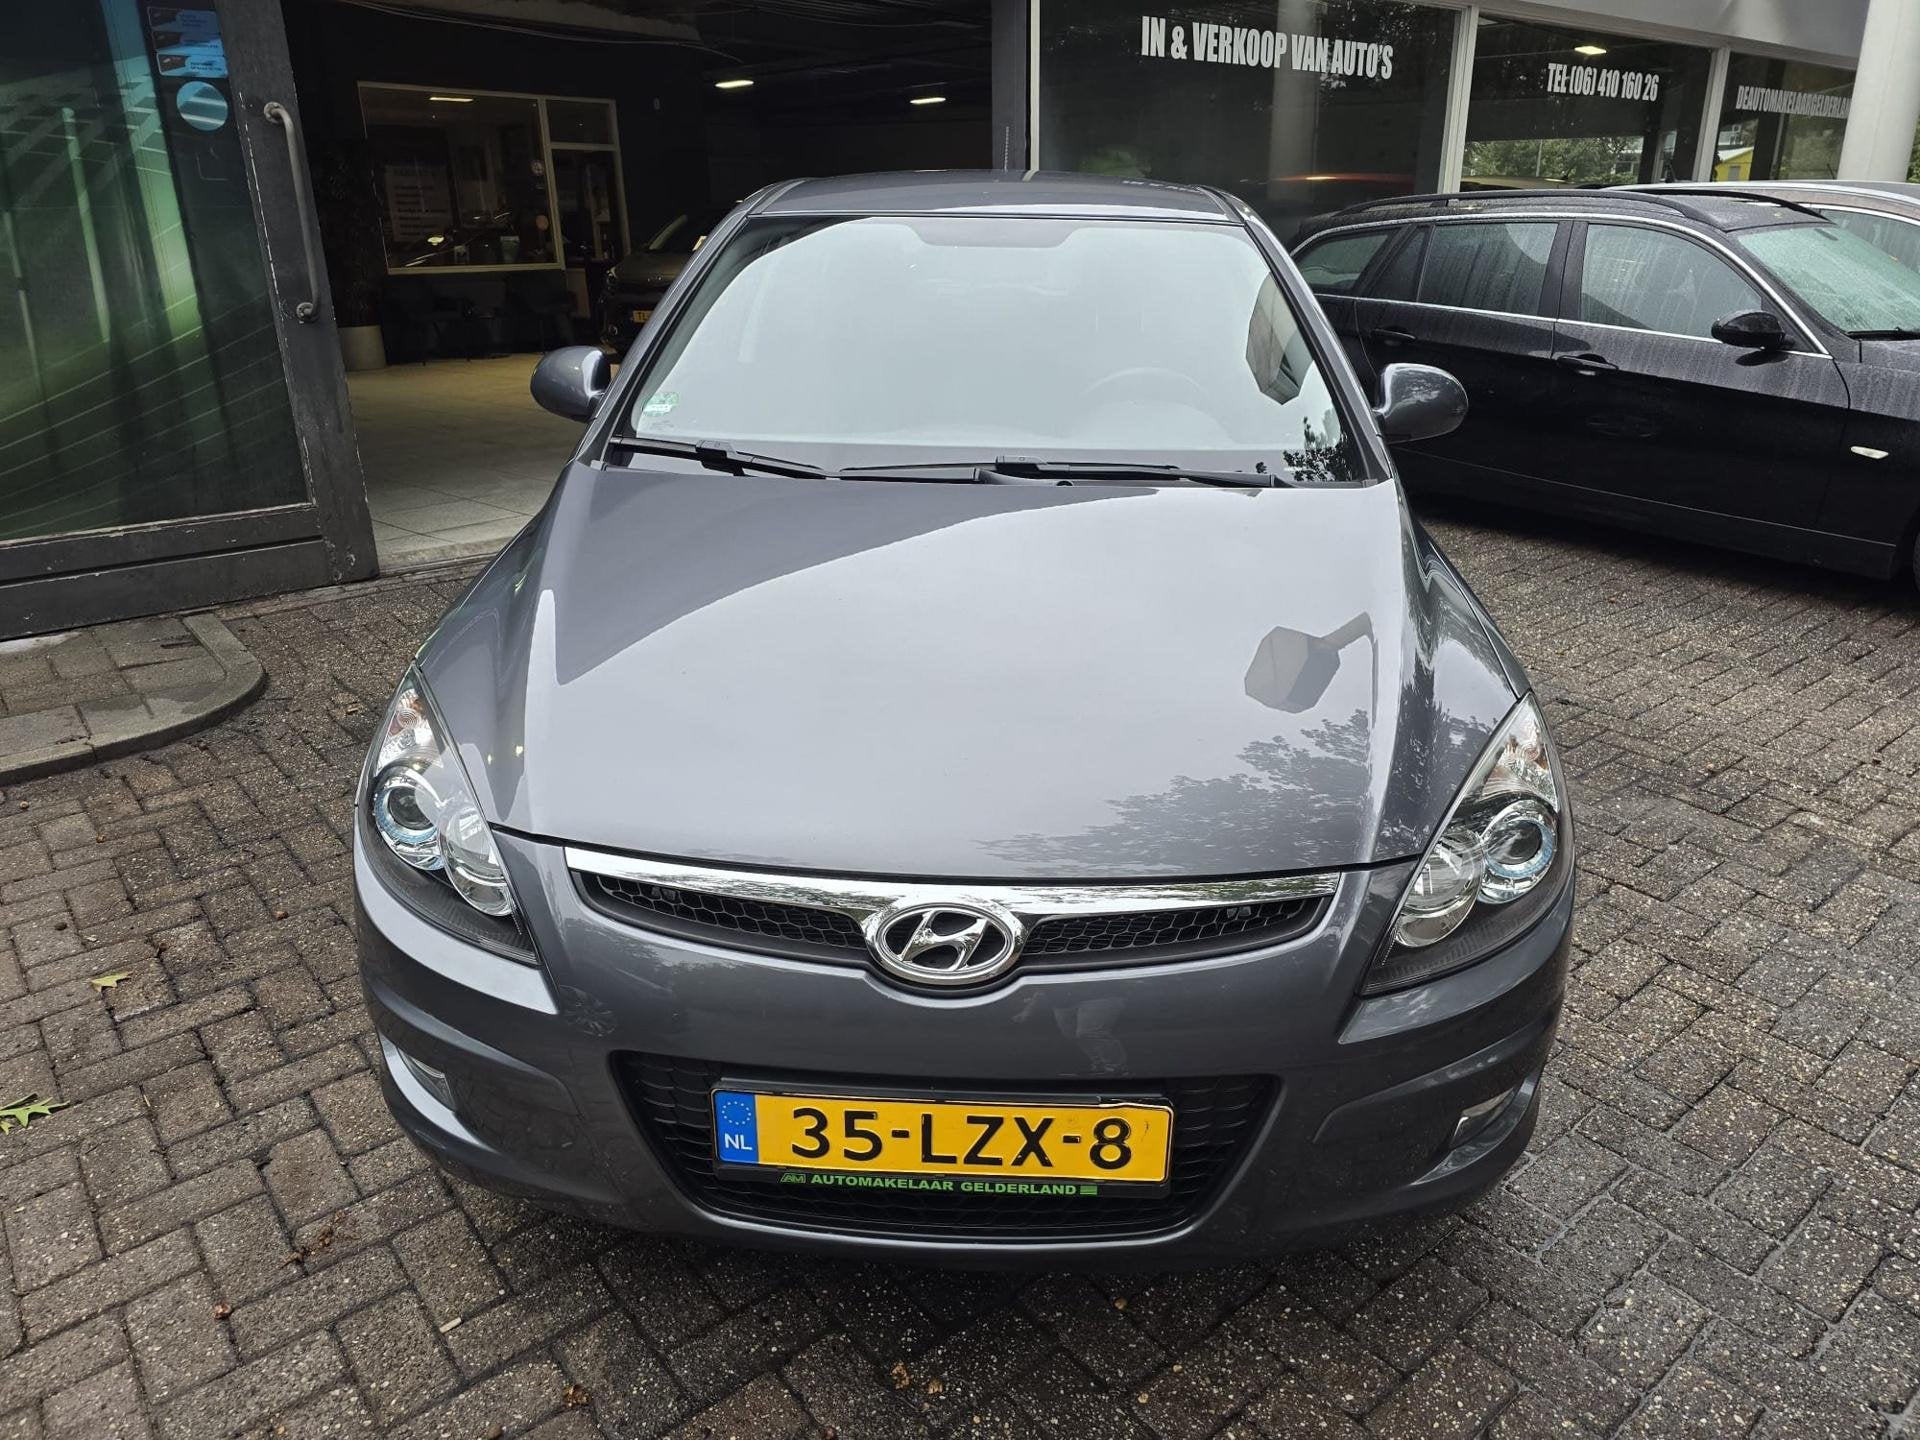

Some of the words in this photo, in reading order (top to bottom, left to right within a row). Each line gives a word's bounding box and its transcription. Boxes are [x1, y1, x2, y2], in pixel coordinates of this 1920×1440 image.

[1141, 15, 1166, 58] IN
[1171, 26, 1187, 60] &
[1192, 22, 1287, 68] VERKOOP
[1291, 34, 1329, 73] VAN
[1330, 39, 1393, 80] AUTO'S
[1569, 65, 1597, 95] (06)
[1597, 68, 1620, 98] 410
[1621, 71, 1643, 100] 160
[1642, 73, 1660, 101] 26
[724, 1134, 752, 1151] NL
[791, 1107, 1132, 1170] 35-LZX-8
[811, 1174, 954, 1191] AUTOMAKELAAR
[960, 1182, 1077, 1195] GELDERLAND
